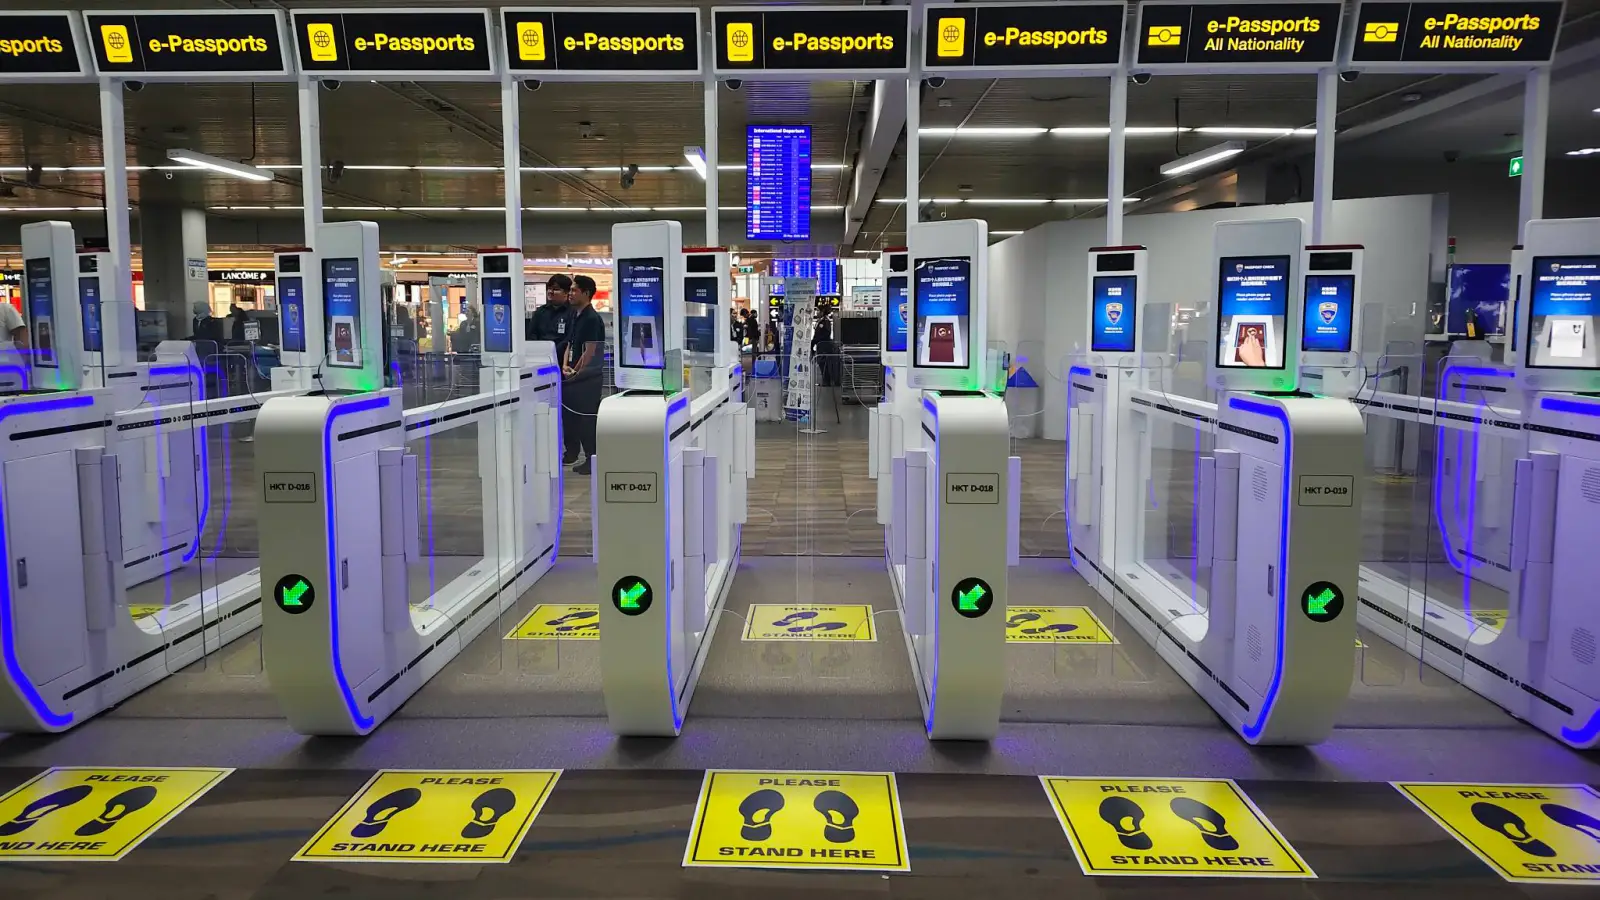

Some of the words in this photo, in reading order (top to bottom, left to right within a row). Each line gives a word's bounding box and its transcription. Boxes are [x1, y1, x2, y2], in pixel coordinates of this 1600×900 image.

[1206, 16, 1321, 33] e-Passports
[1424, 13, 1541, 32] e-Passports
[772, 32, 894, 54] e-Passports
[983, 27, 1108, 49] e-Passports
[1420, 35, 1444, 49] All
[1447, 34, 1524, 51] Nationality
[149, 35, 268, 55] e-Passports
[355, 33, 475, 54] e-Passports
[563, 32, 685, 55] e-Passports
[1203, 38, 1230, 51] All
[1234, 37, 1305, 53] Nationality
[221, 271, 259, 280] LANCÔME
[269, 483, 286, 491] HKT
[610, 483, 628, 491] HKT
[629, 483, 652, 492] D-017
[951, 484, 969, 492] HKT
[970, 484, 994, 492] D-018
[1304, 486, 1323, 494] HKT
[1324, 486, 1348, 495] D-019
[84, 774, 170, 783] PLEASE
[419, 777, 504, 785] PLEASE
[758, 778, 841, 787] PLEASE
[1100, 785, 1186, 794] PLEASE
[1457, 791, 1551, 801] PLEASE
[36, 841, 108, 851] HERE
[330, 843, 416, 852] STAND
[419, 843, 488, 853] HERE
[718, 846, 803, 858] STAND
[810, 848, 876, 859] HERE
[1110, 855, 1199, 866] STAND
[1205, 856, 1275, 867] HERE
